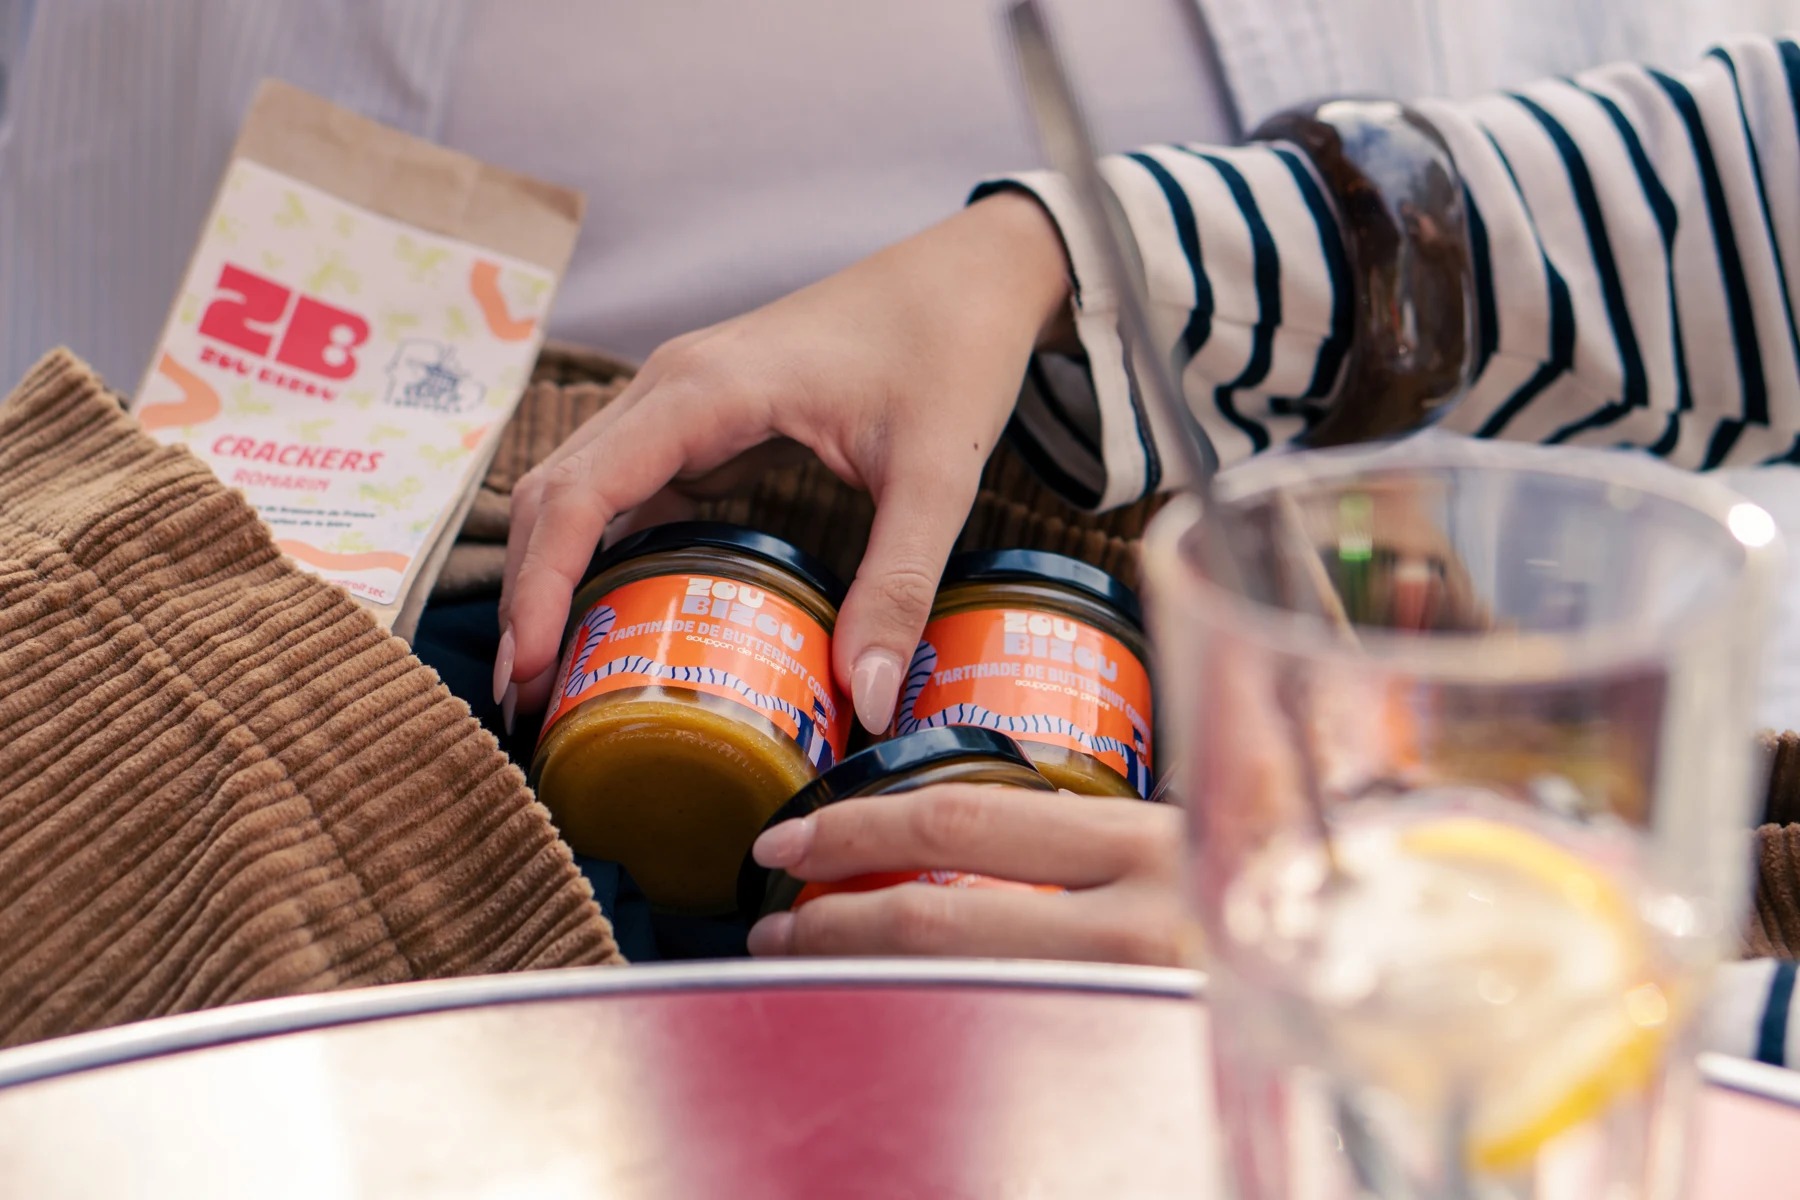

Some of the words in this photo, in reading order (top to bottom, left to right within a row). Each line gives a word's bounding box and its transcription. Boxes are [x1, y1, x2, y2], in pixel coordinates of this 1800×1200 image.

[211, 434, 385, 473] CRACKERS
[231, 468, 331, 491] ROMARIN
[686, 578, 765, 609] ZOU
[681, 594, 805, 652] BIZOU
[1004, 612, 1078, 642] ZOU
[608, 619, 695, 644] TARTINADE
[697, 622, 720, 637] DE
[723, 627, 808, 680] BUTTERNUT
[737, 645, 752, 657] de
[754, 653, 788, 676] piment
[1004, 631, 1118, 683] BIZOU
[934, 661, 1021, 686] TARTINADE
[1024, 663, 1044, 680] DE
[1048, 666, 1125, 712] BUTTERNUT
[1064, 686, 1078, 697] de
